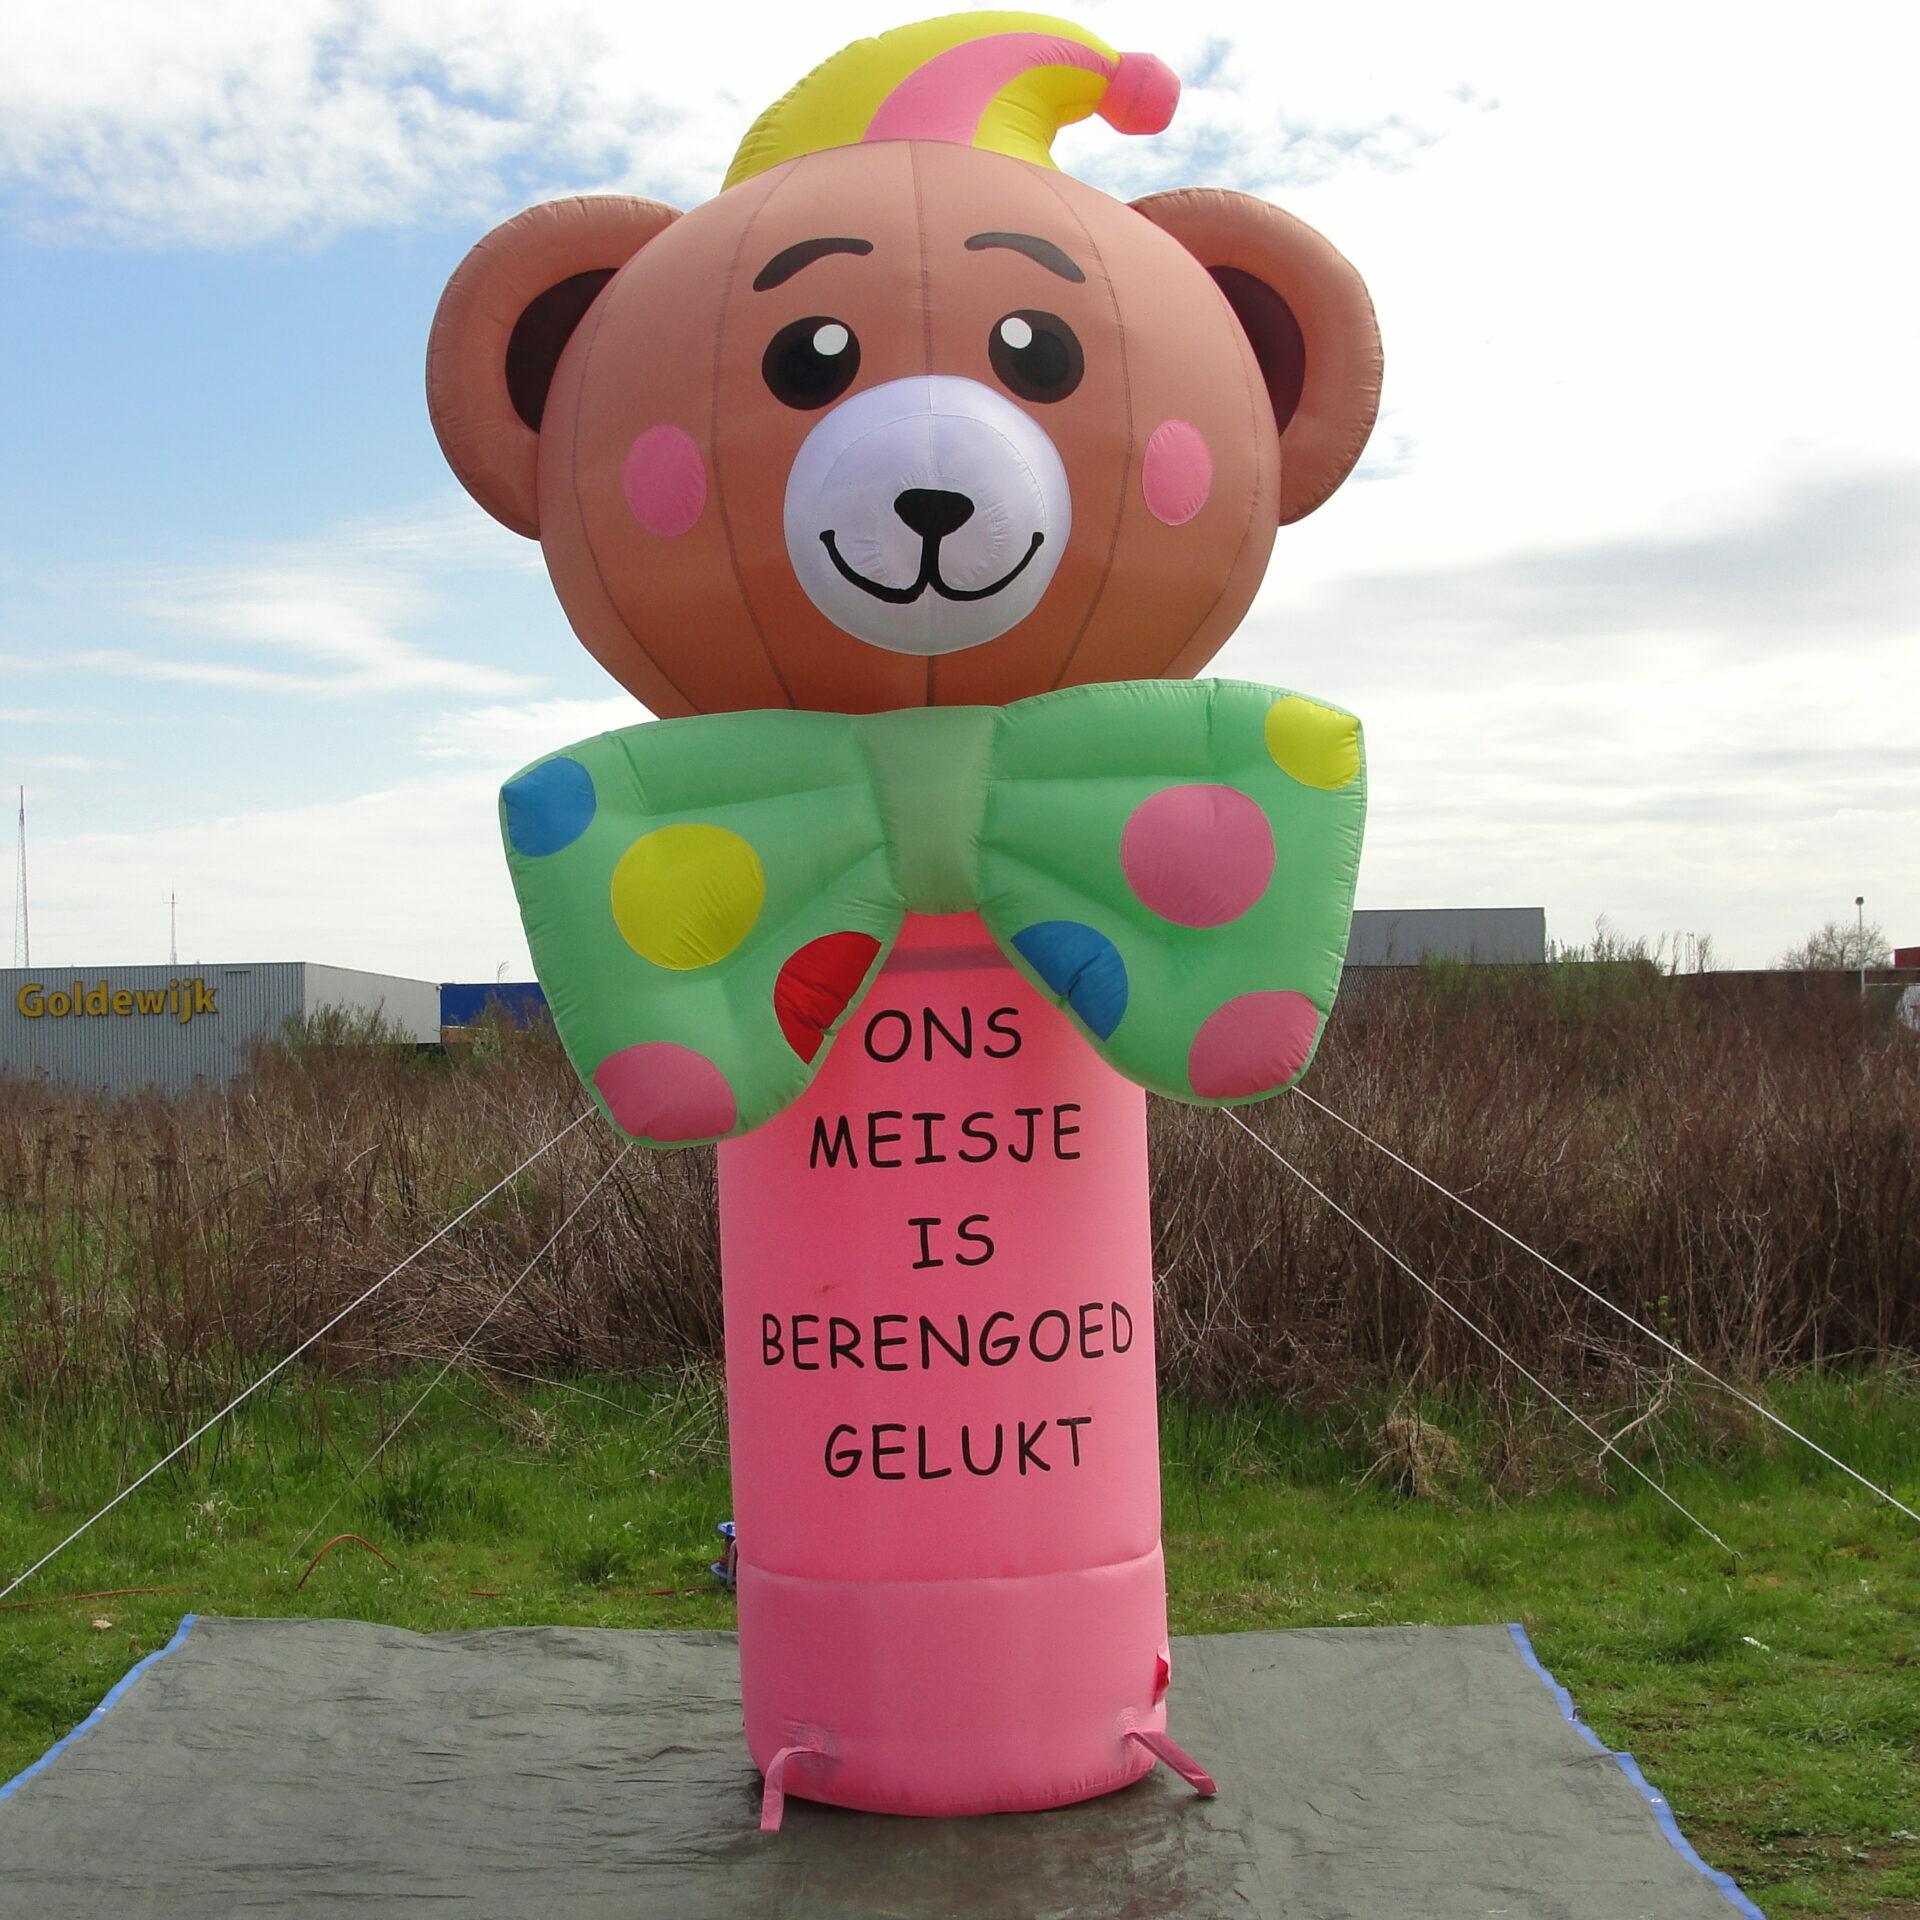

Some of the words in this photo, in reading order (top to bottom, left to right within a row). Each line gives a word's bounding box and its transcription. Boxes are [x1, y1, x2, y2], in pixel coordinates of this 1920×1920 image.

[17, 979, 219, 1024] Goldewijk
[865, 1006, 1022, 1063] ONS
[810, 1103, 1082, 1169] MEISJE
[907, 1214, 995, 1270] IS
[762, 1302, 1134, 1372] BERENGOED
[824, 1416, 1092, 1480] GELUKT
